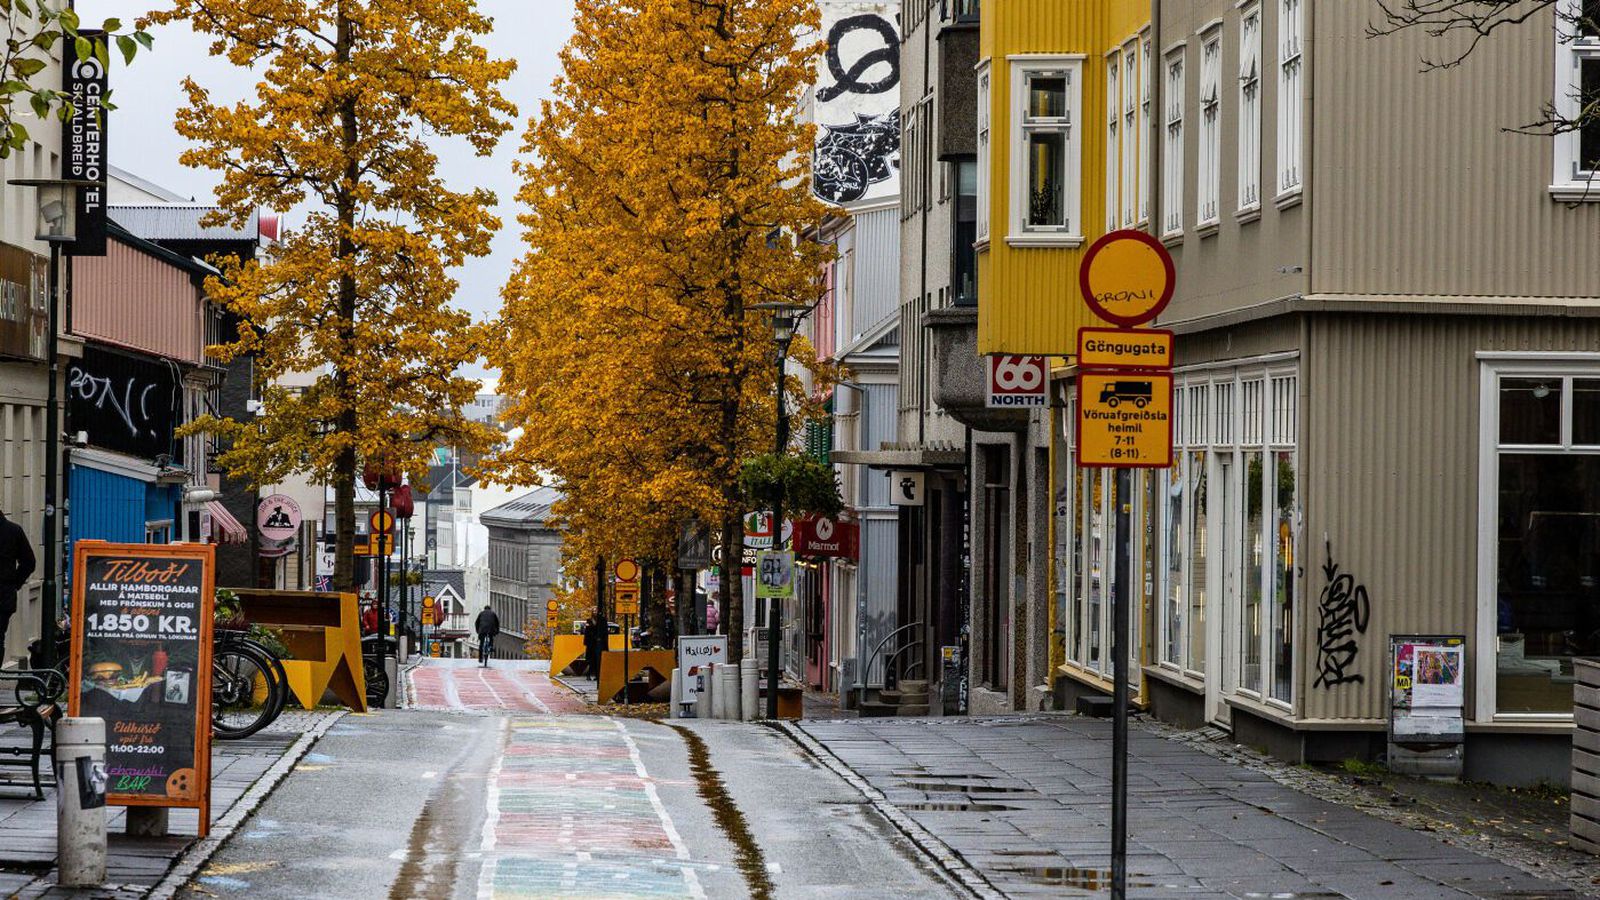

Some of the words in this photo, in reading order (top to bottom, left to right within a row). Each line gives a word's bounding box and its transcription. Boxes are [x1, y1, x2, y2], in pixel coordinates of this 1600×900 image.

[1085, 340, 1165, 356] Göngugata
[992, 396, 1045, 405] NORTH
[1083, 409, 1167, 421] Vöruafgreiðsla
[1108, 423, 1142, 432] heimil
[1114, 436, 1135, 445] 7-11
[1110, 448, 1139, 460] (8-11)
[808, 541, 839, 551] Marmot
[103, 560, 189, 583] Tilboð!
[90, 583, 118, 591] ALLIR
[120, 584, 199, 593] HAMBORGARAR
[118, 591, 125, 599] Á
[120, 600, 165, 608] FRÖNSKUM
[87, 613, 149, 632] 1.850
[158, 615, 197, 633] KR.
[110, 745, 164, 754] 11:00-22:00
